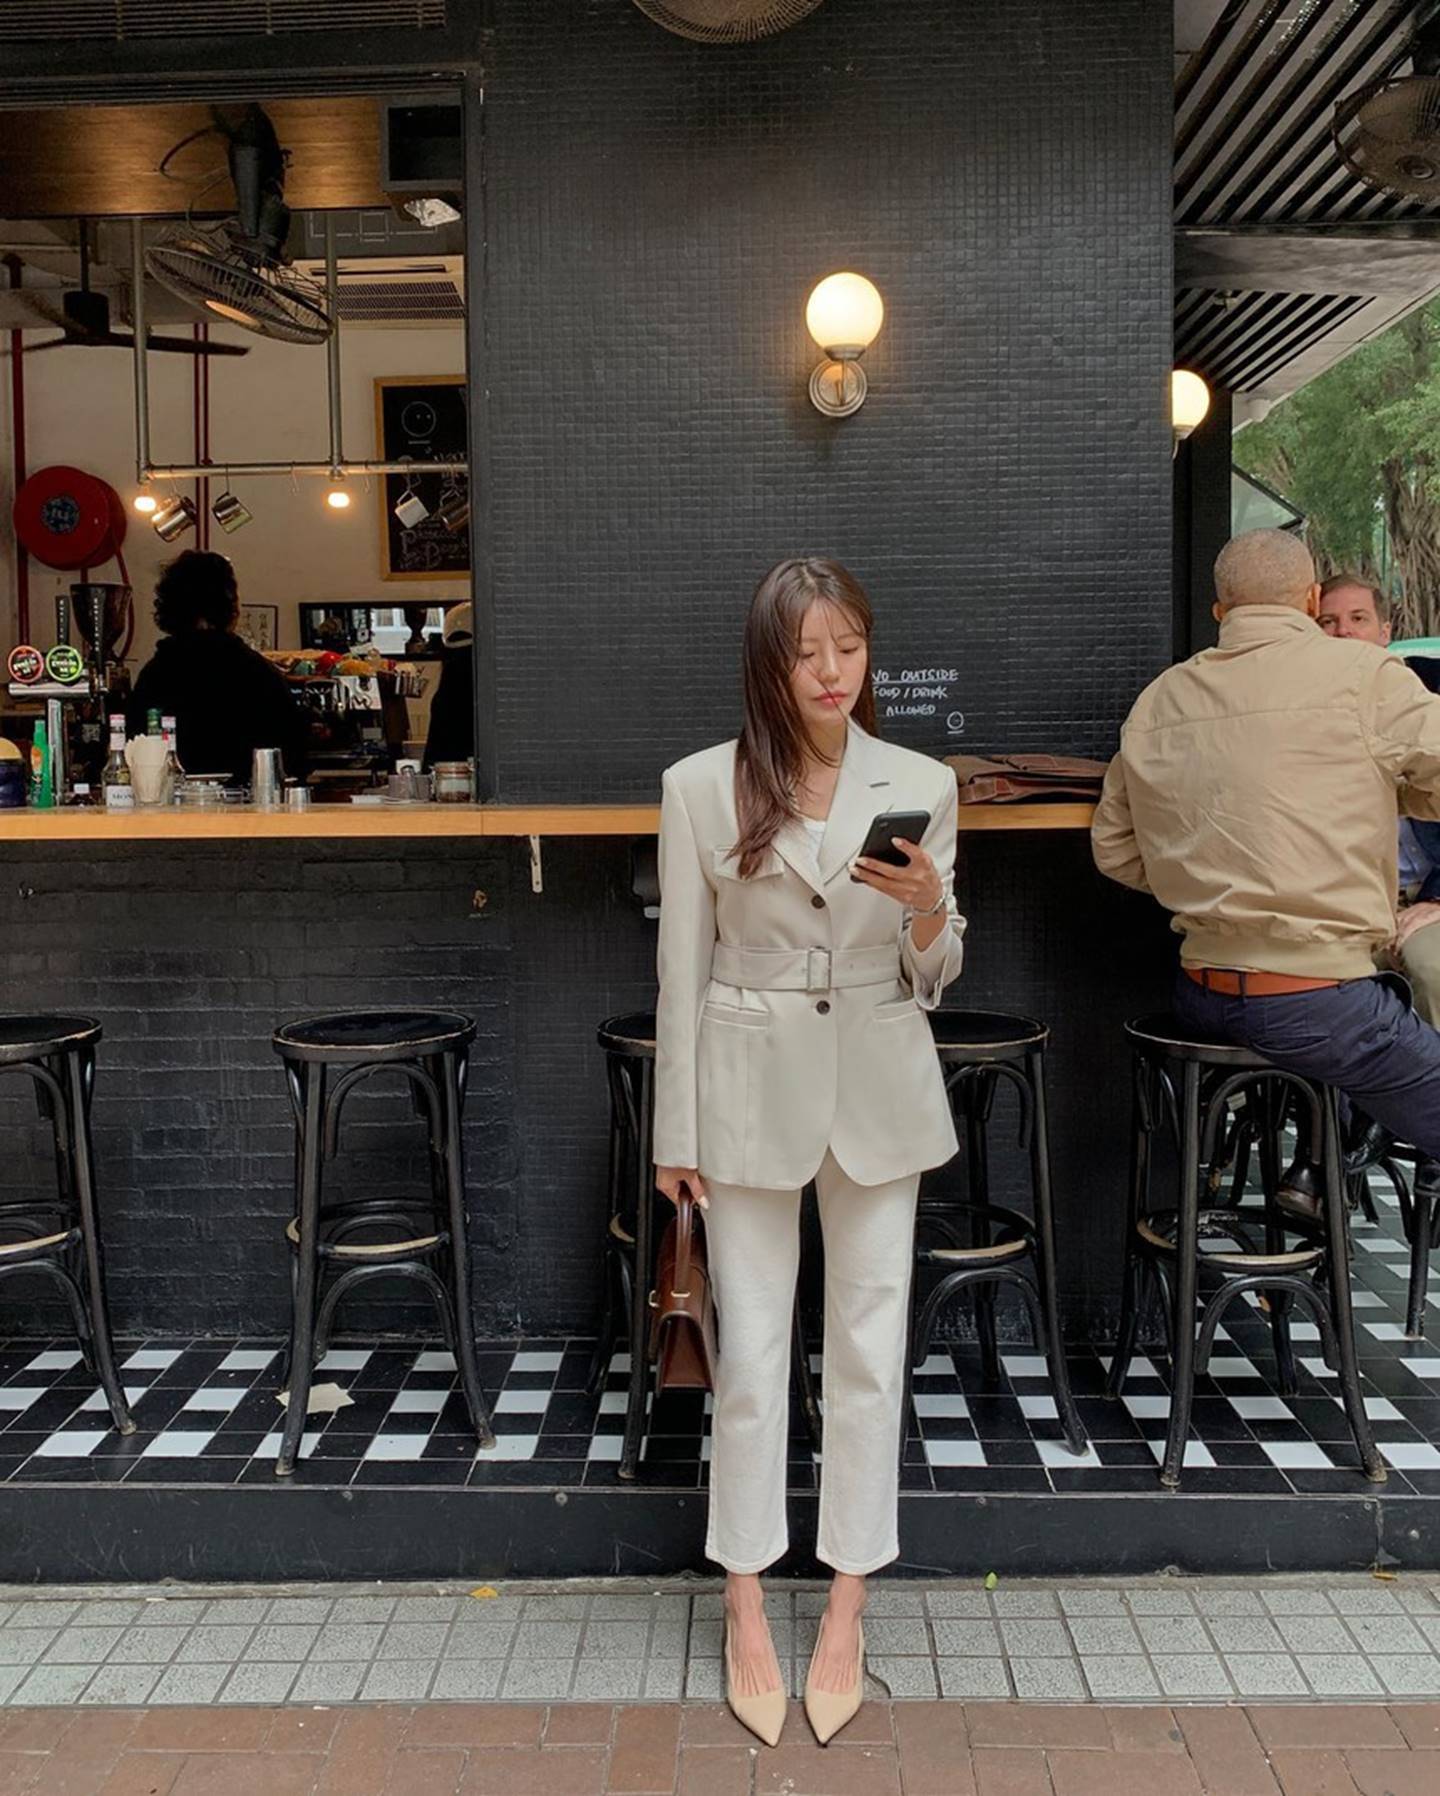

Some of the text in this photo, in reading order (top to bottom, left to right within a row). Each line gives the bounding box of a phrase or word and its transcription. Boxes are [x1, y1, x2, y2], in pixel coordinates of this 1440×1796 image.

[900, 668, 959, 682] OUTSIDE
[912, 685, 949, 700] DRINK
[886, 704, 936, 717] ALLOWED
